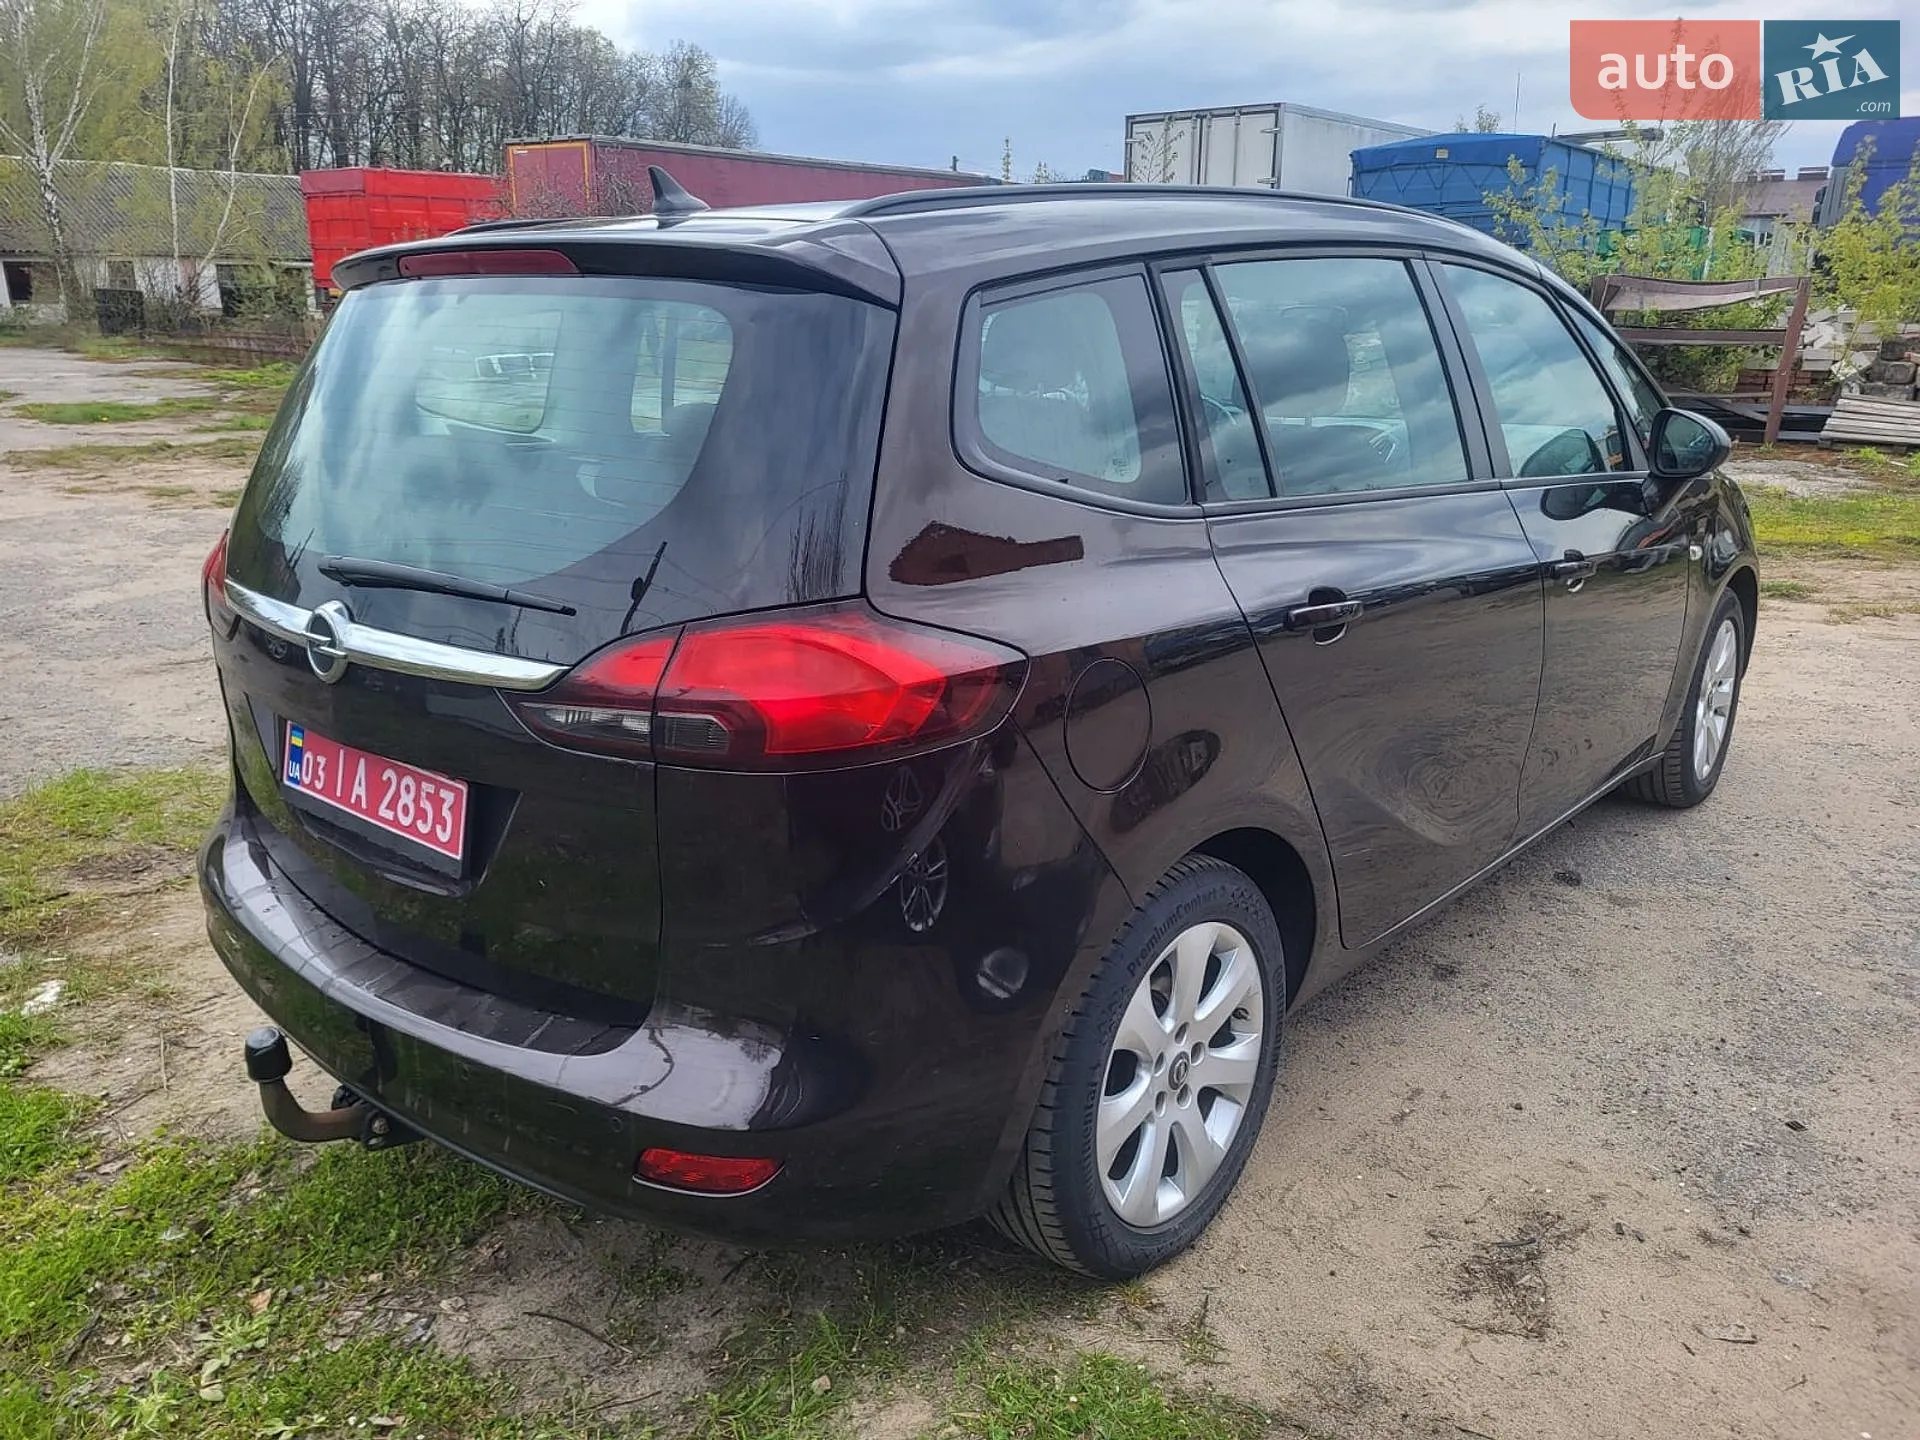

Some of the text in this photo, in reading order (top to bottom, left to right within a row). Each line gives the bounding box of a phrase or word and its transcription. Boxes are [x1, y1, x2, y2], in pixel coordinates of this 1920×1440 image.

[288, 760, 301, 780] UA
[301, 749, 456, 843] 03 IA 2853
